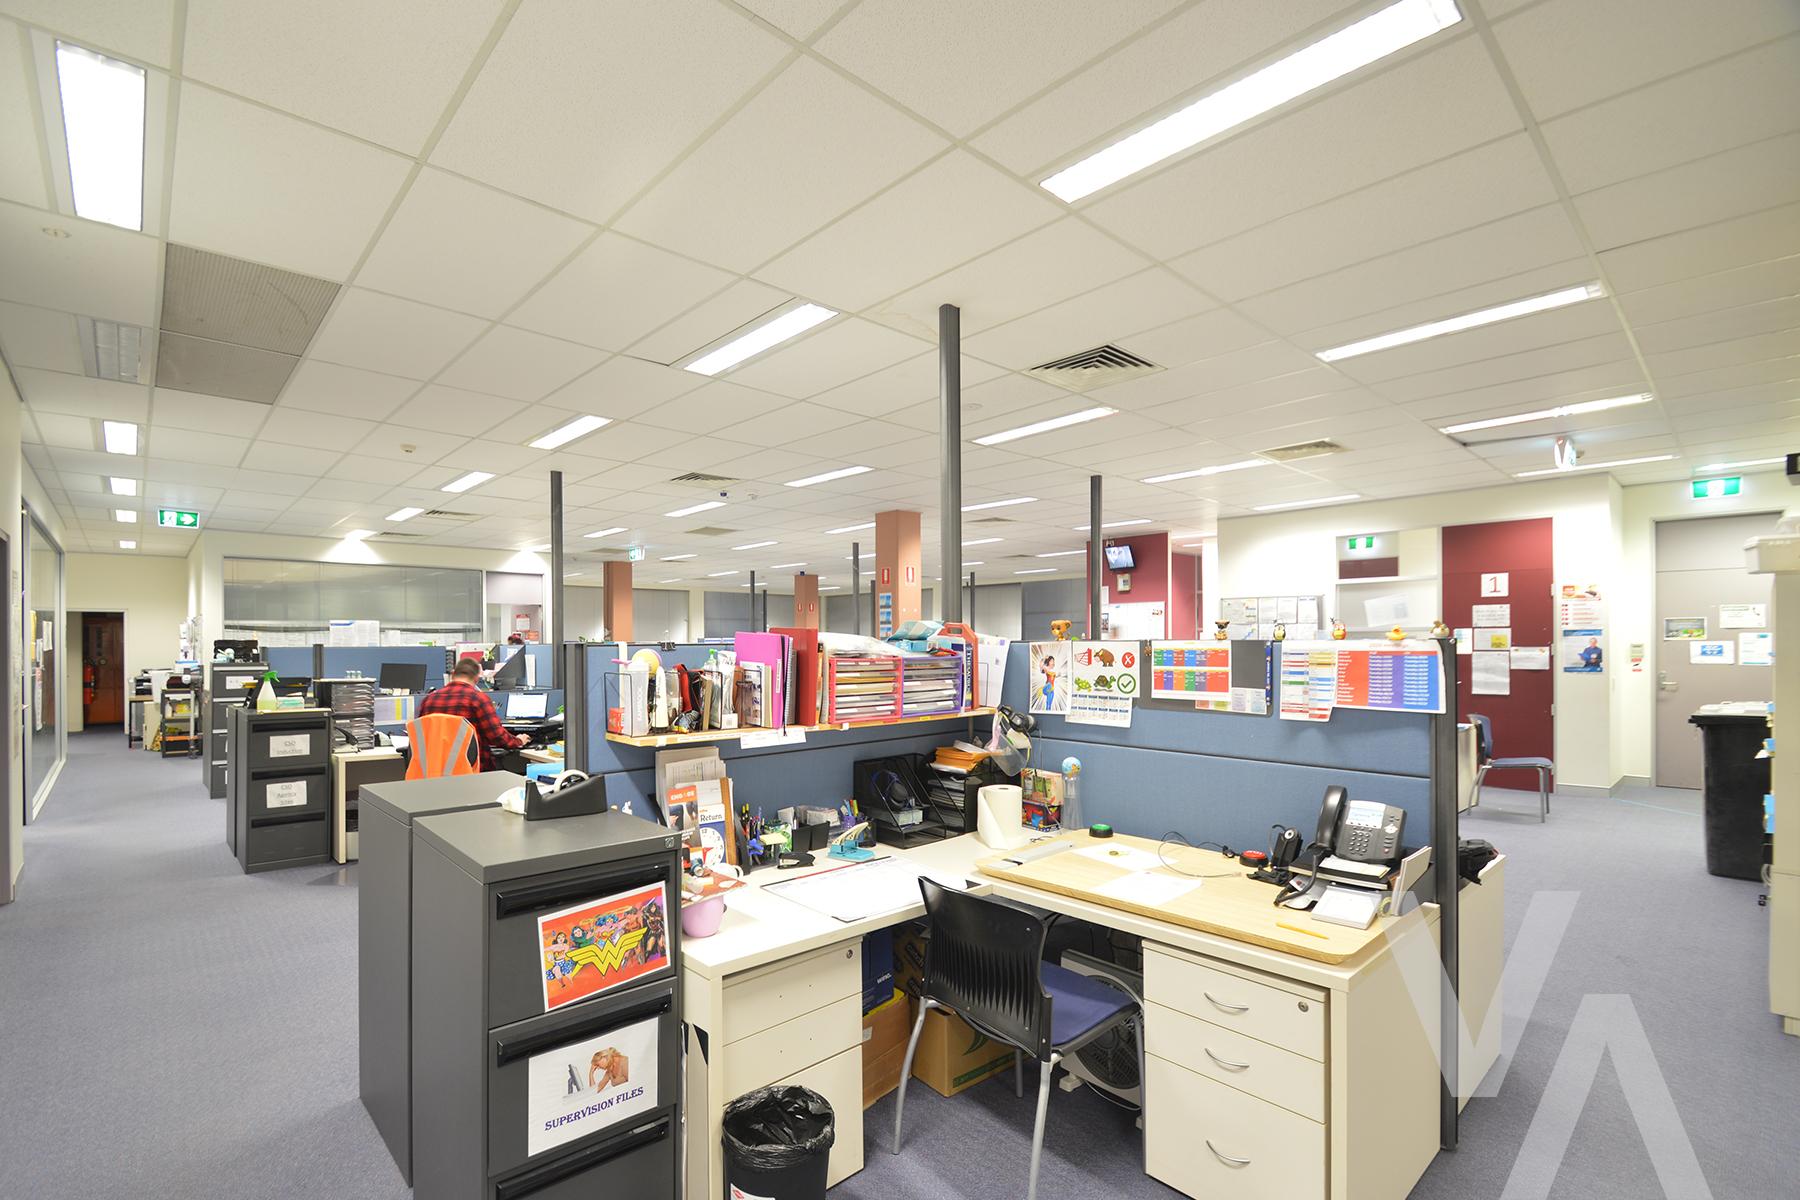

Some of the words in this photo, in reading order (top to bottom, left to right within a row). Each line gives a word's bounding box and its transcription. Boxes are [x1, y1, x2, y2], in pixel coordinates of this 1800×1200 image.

[1489, 576, 1501, 593] 1
[700, 814, 723, 822] Return
[544, 1098, 614, 1131] SUPERVISION
[616, 1087, 644, 1104] FILES
